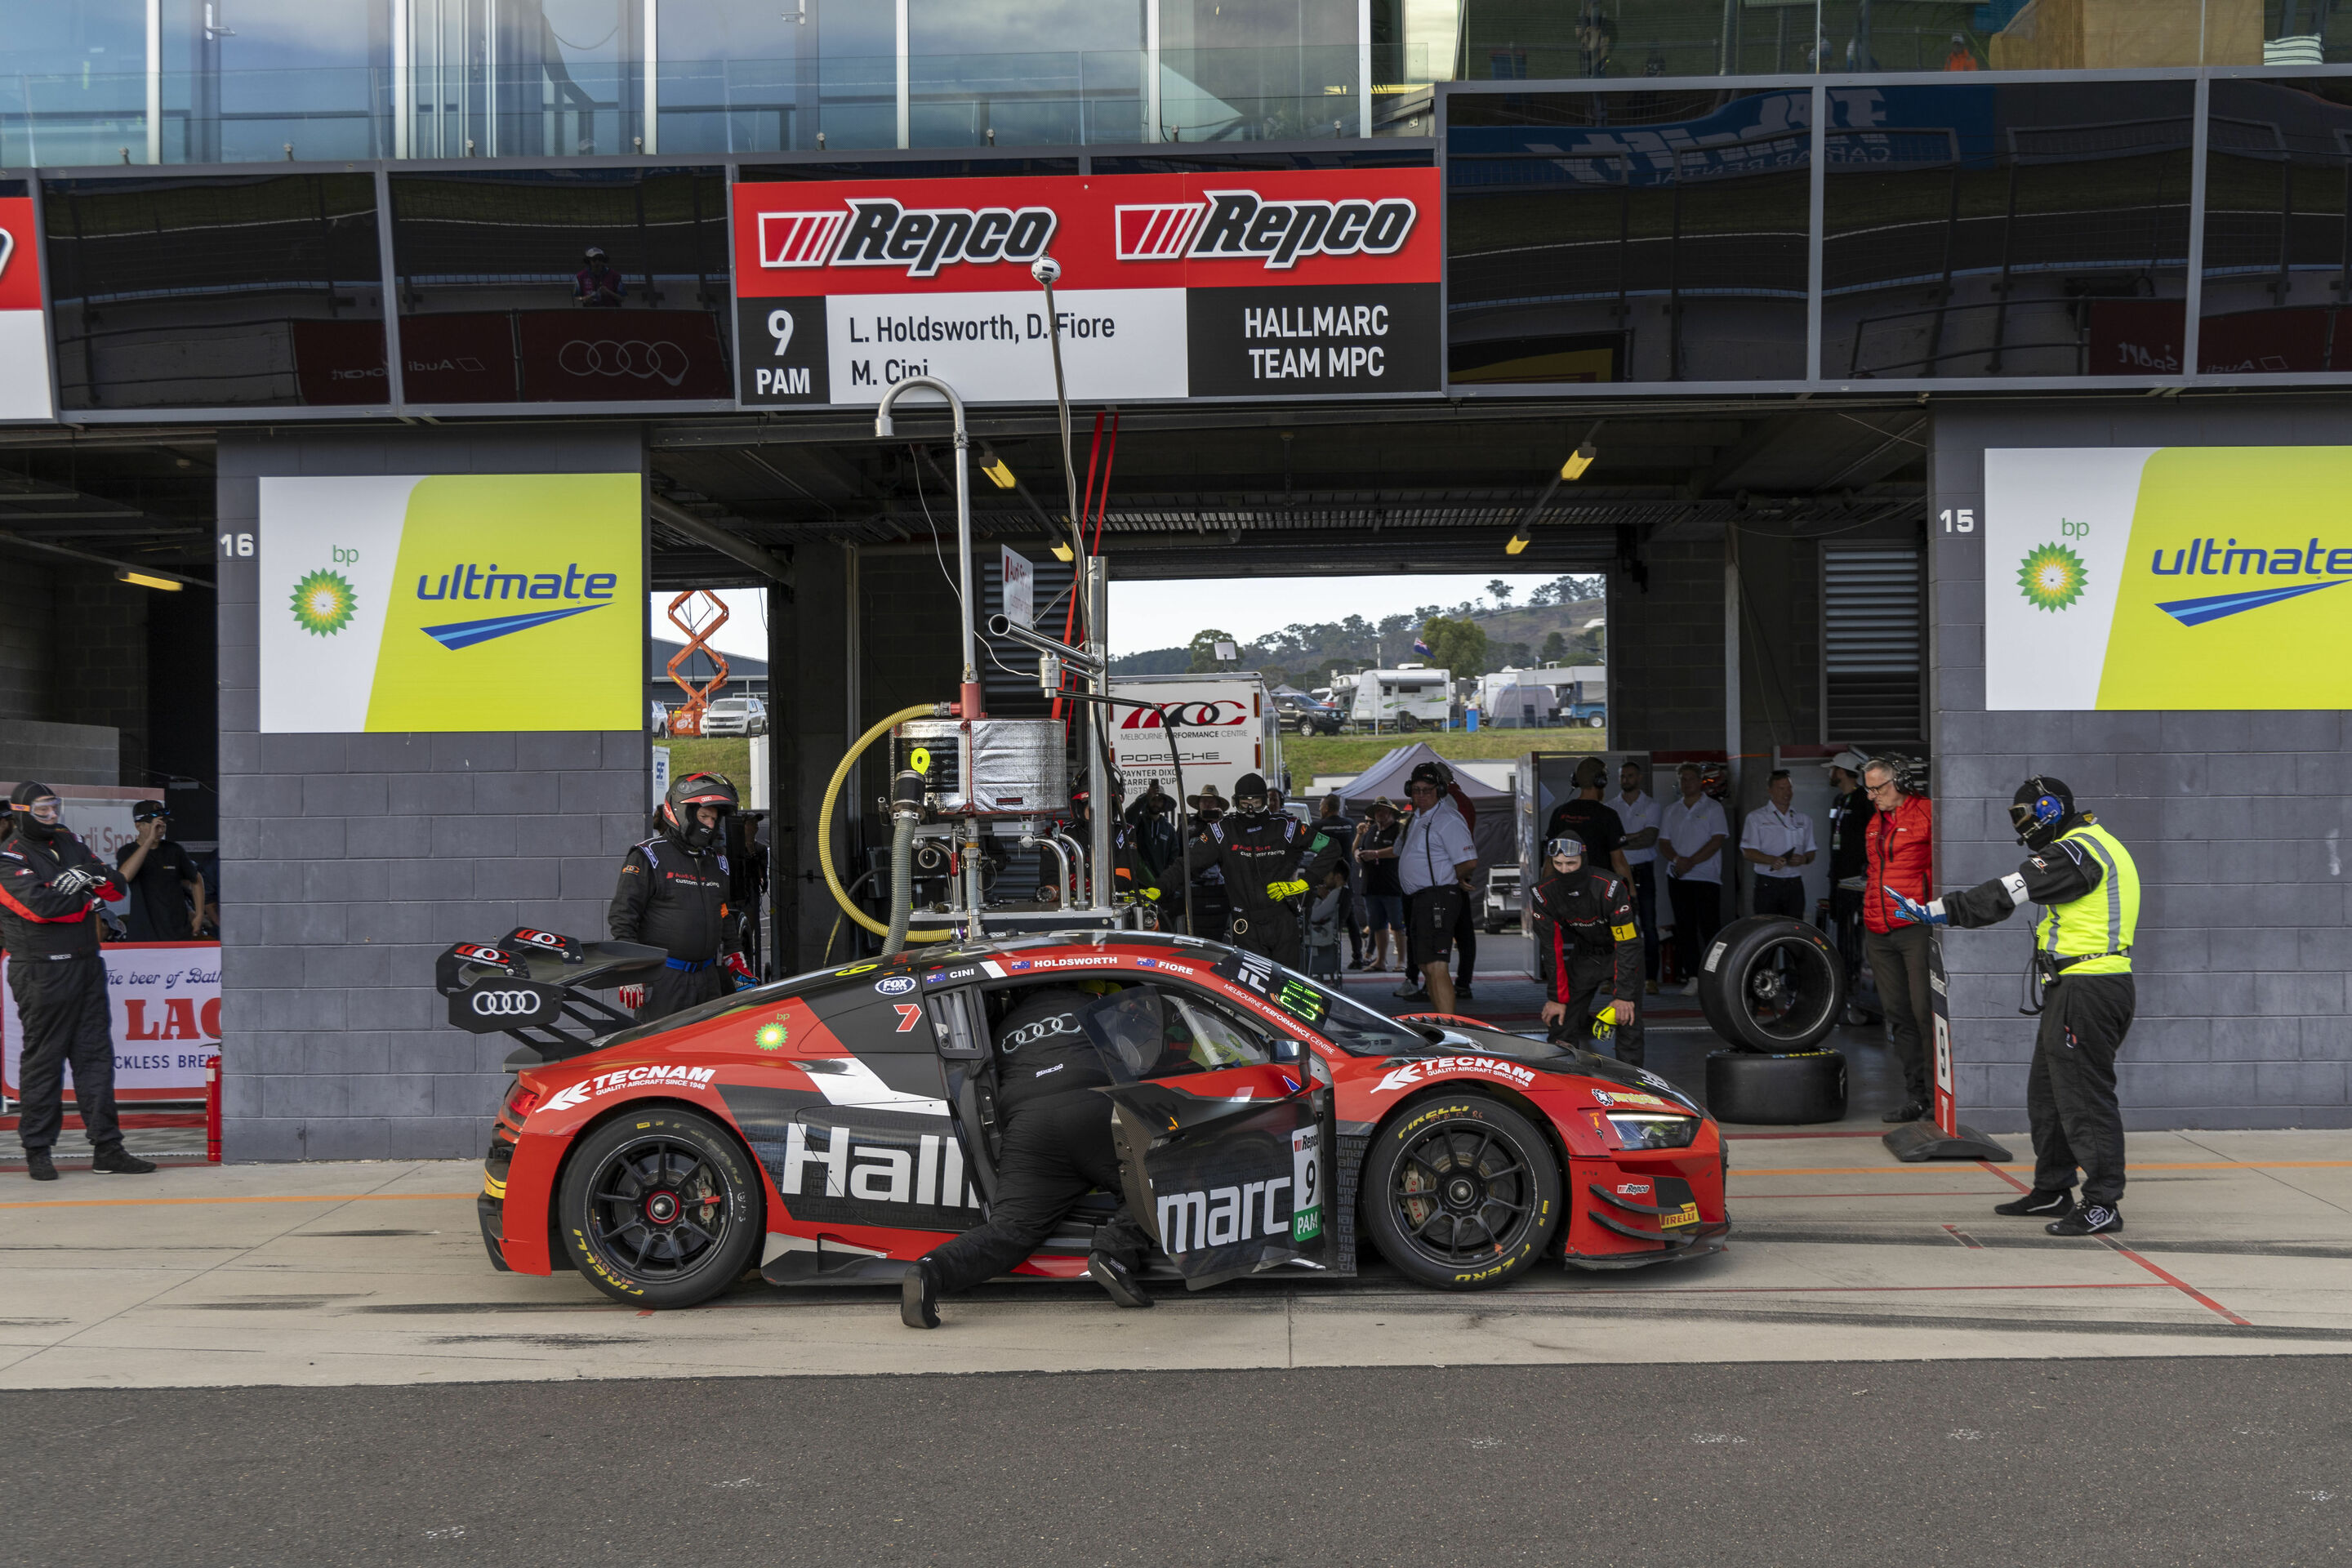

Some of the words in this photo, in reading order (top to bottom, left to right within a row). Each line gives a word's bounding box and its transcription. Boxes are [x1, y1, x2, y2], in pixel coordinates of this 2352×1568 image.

[831, 198, 1058, 278] Repco
[1187, 189, 1417, 270] Repco
[768, 310, 794, 357] 9
[849, 317, 870, 343] L.
[876, 314, 1020, 345] Holdsworth,
[1027, 313, 1049, 340] D.
[1055, 312, 1116, 340] Fiore
[1245, 306, 1389, 339] HALLMARC
[852, 359, 878, 385] M.
[1250, 349, 1321, 379] TEAM
[1329, 347, 1384, 376] MPC
[756, 368, 810, 396] PAM
[1940, 509, 1974, 532] 15
[2061, 517, 2090, 541] bp
[220, 532, 254, 557] 16
[332, 545, 359, 568] bp
[2151, 537, 2352, 575] ultimate
[416, 563, 617, 600] ultimate
[1120, 733, 1163, 741] MELBOURNE
[1165, 730, 1219, 739] PRFORMANCE
[1220, 729, 1248, 737] CENTRE
[1120, 751, 1219, 763] PORSCHE
[2011, 880, 2026, 894] 9
[1615, 927, 1625, 939] 9
[949, 968, 975, 979] CINI
[1034, 956, 1118, 968] HOLDSWORTH
[1158, 960, 1194, 975] FIORE
[129, 971, 161, 985] beer
[165, 970, 184, 989] of
[882, 978, 910, 990] FOX
[777, 1013, 790, 1022] bp
[1223, 983, 1263, 1008] MELBOURNE
[1262, 1005, 1311, 1039] PERFORMANCE
[1310, 1036, 1336, 1055] CENTRE
[592, 1065, 716, 1088] TECNAM
[1421, 1057, 1536, 1083] TECNAM
[1427, 1067, 1457, 1076] QUALITY
[1457, 1066, 1492, 1075] AIRCRAFT
[1492, 1069, 1514, 1080] SINCE
[595, 1084, 627, 1096] QUALITY
[626, 1078, 665, 1090] AIRCRAFT
[665, 1077, 688, 1086] SINCE
[688, 1081, 706, 1091] 1948
[1305, 1159, 1316, 1205] 9
[1625, 1184, 1649, 1195] Repco
[1157, 1176, 1291, 1255] marc
[1297, 1211, 1318, 1236] PAM
